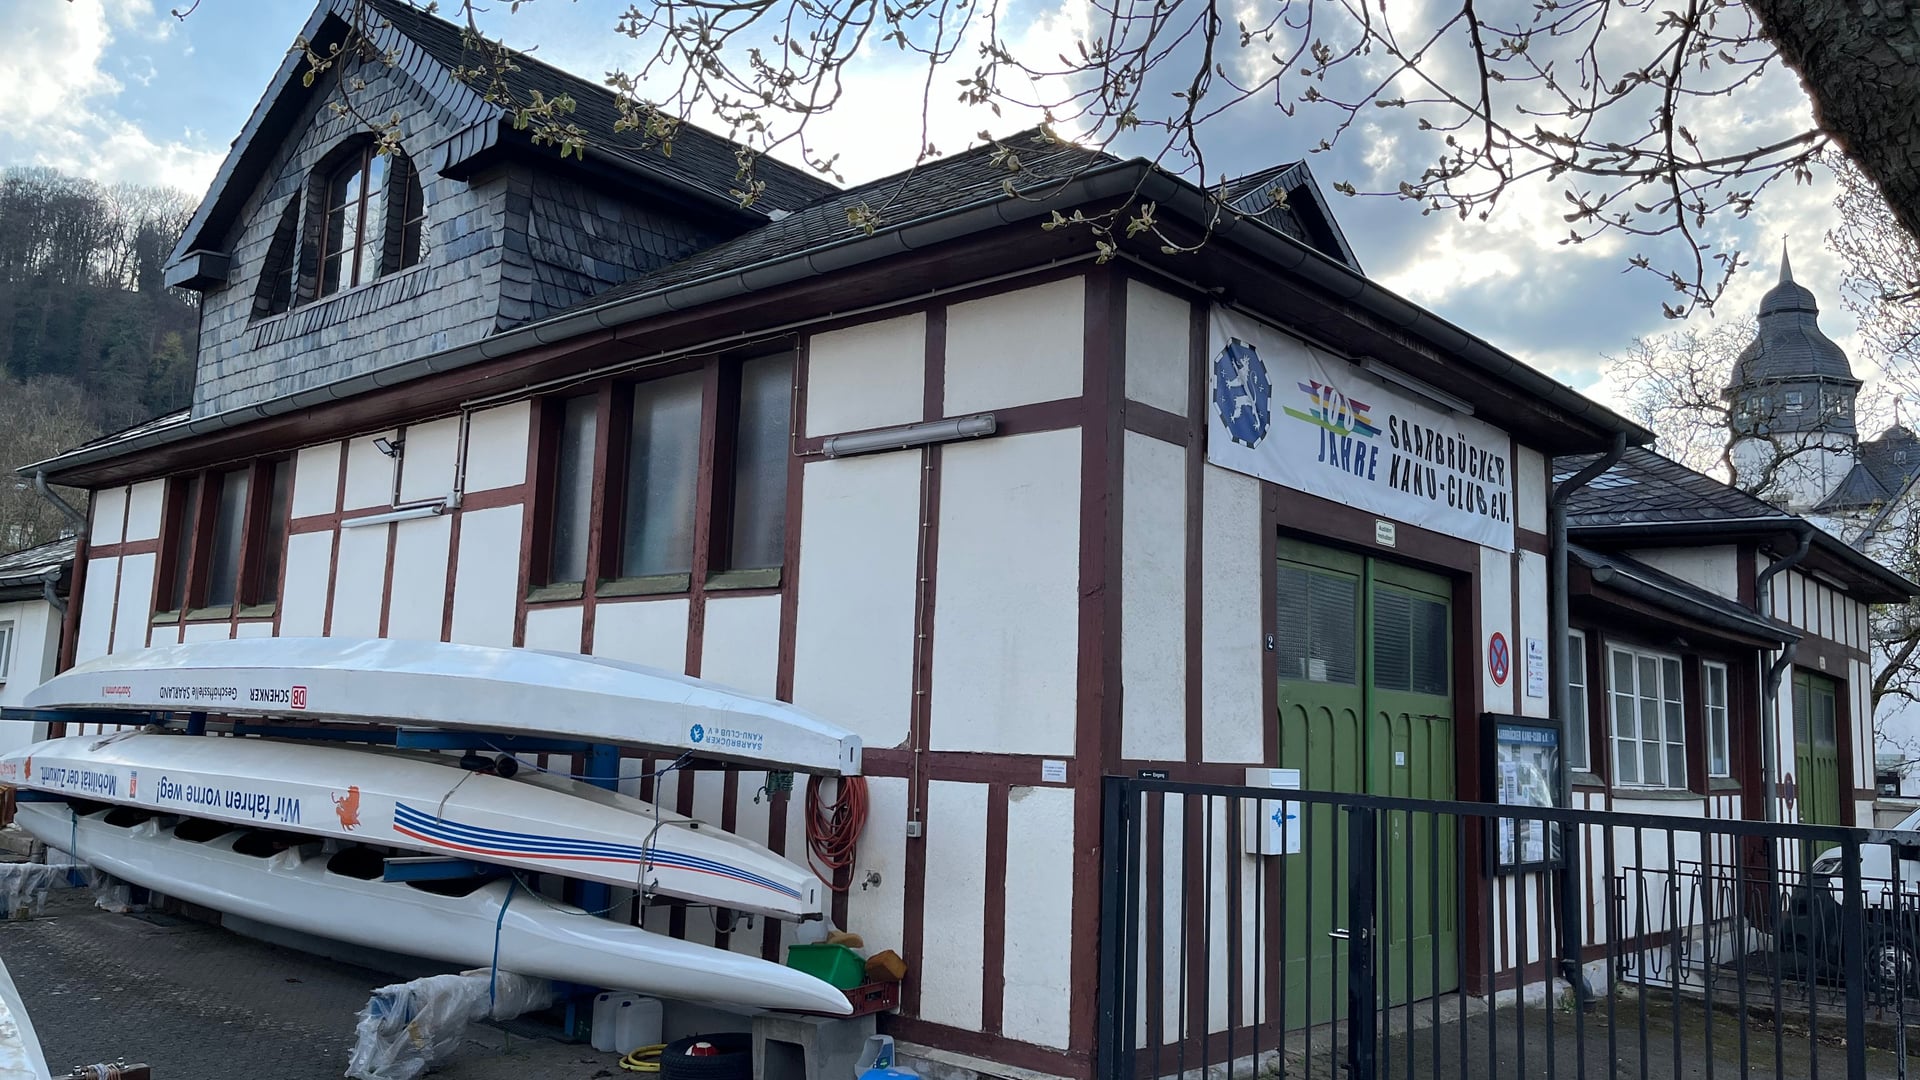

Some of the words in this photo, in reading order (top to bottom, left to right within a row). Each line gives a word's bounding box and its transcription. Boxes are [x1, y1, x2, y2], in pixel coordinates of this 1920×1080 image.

[1318, 382, 1356, 432] 100
[1318, 426, 1379, 482] JAHRE
[1389, 414, 1505, 487] SAARBRÜCKER
[1389, 453, 1488, 516] KANU-CLUB
[1491, 492, 1510, 524] e.V.
[1268, 635, 1274, 649] 2
[160, 686, 190, 699] SAARLAND
[192, 686, 238, 701] Geschäftsstelle
[250, 687, 290, 703] SCHENKER
[292, 687, 306, 707] DB
[706, 736, 762, 751] SAARBRÜCKER
[721, 728, 764, 741] KANU-CLUB
[66, 768, 79, 790] der
[81, 771, 117, 796] Mobilität
[156, 776, 182, 804] weg!
[187, 785, 221, 806] vorne
[225, 790, 270, 820] fahren
[274, 797, 300, 825] Wir
